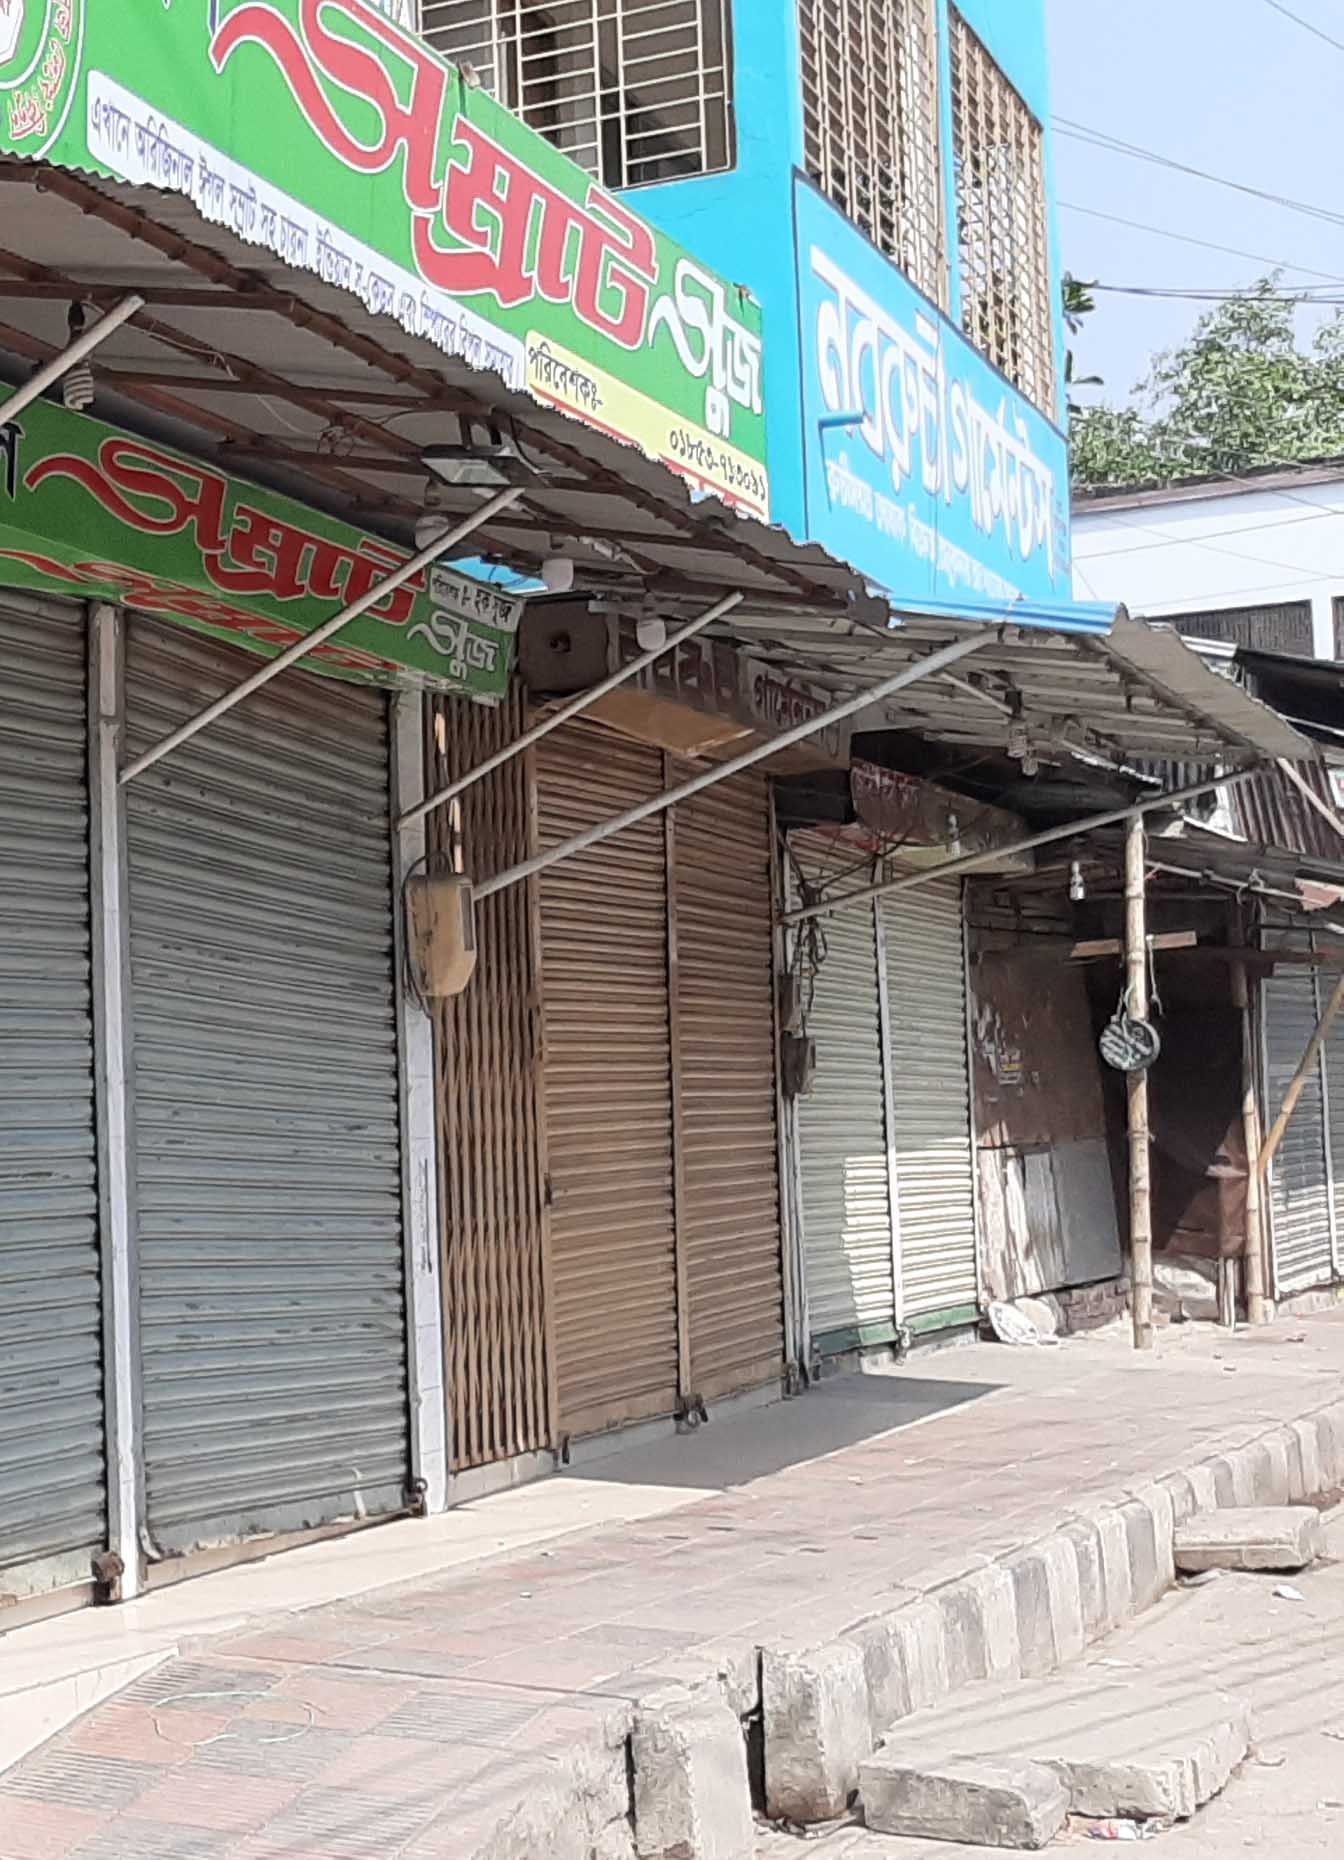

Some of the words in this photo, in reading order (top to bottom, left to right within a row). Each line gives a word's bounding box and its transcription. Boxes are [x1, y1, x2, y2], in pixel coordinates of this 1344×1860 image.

[90, 96, 132, 161] এখানে
[210, 0, 659, 351] সম্রাট
[23, 436, 428, 626] সম্রাট
